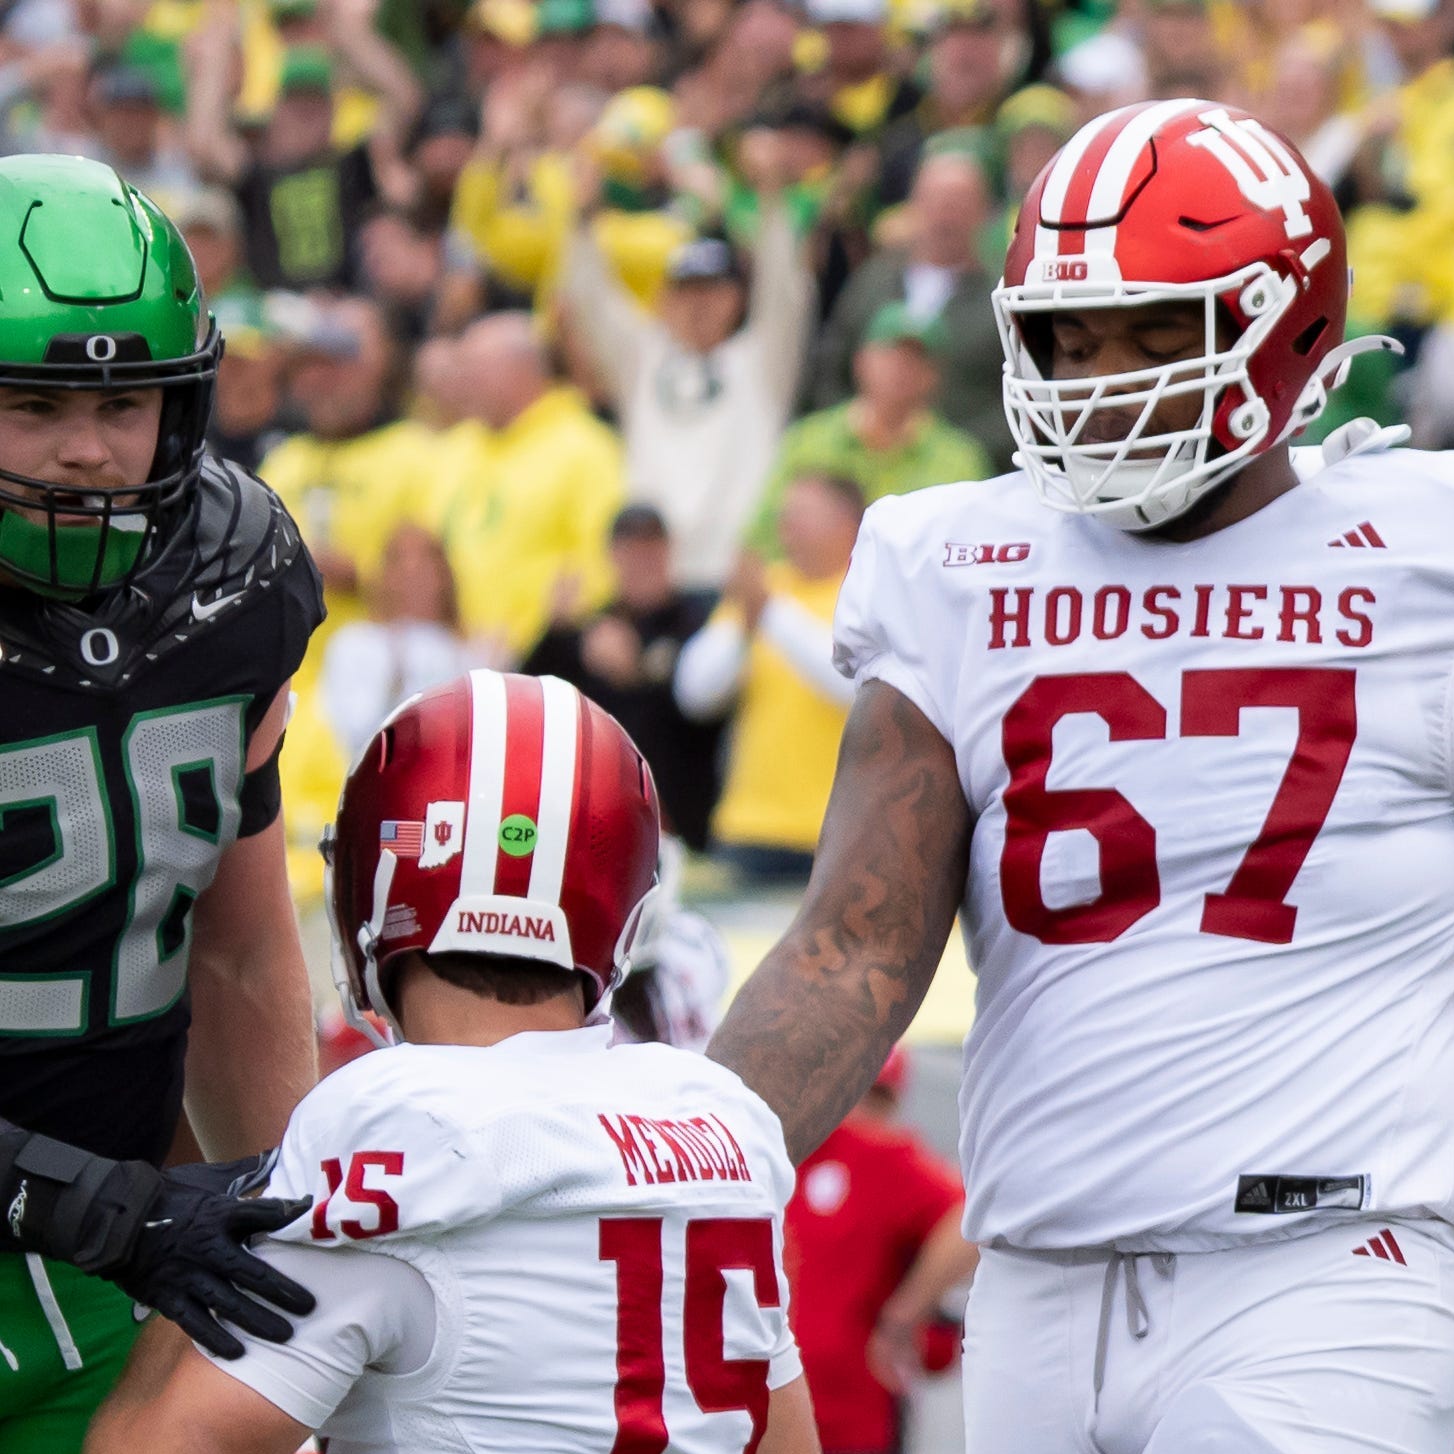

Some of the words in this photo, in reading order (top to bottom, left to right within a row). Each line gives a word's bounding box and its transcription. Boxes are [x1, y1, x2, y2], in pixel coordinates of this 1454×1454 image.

[986, 584, 1377, 651] HOOSIERS
[80, 626, 120, 667] O
[1000, 667, 1358, 946] 67
[501, 826, 535, 843] C2P
[456, 911, 556, 943] INDIANA
[597, 1112, 752, 1186] MENDOZA
[310, 1150, 405, 1240] 15
[1284, 1191, 1308, 1207] 2XL
